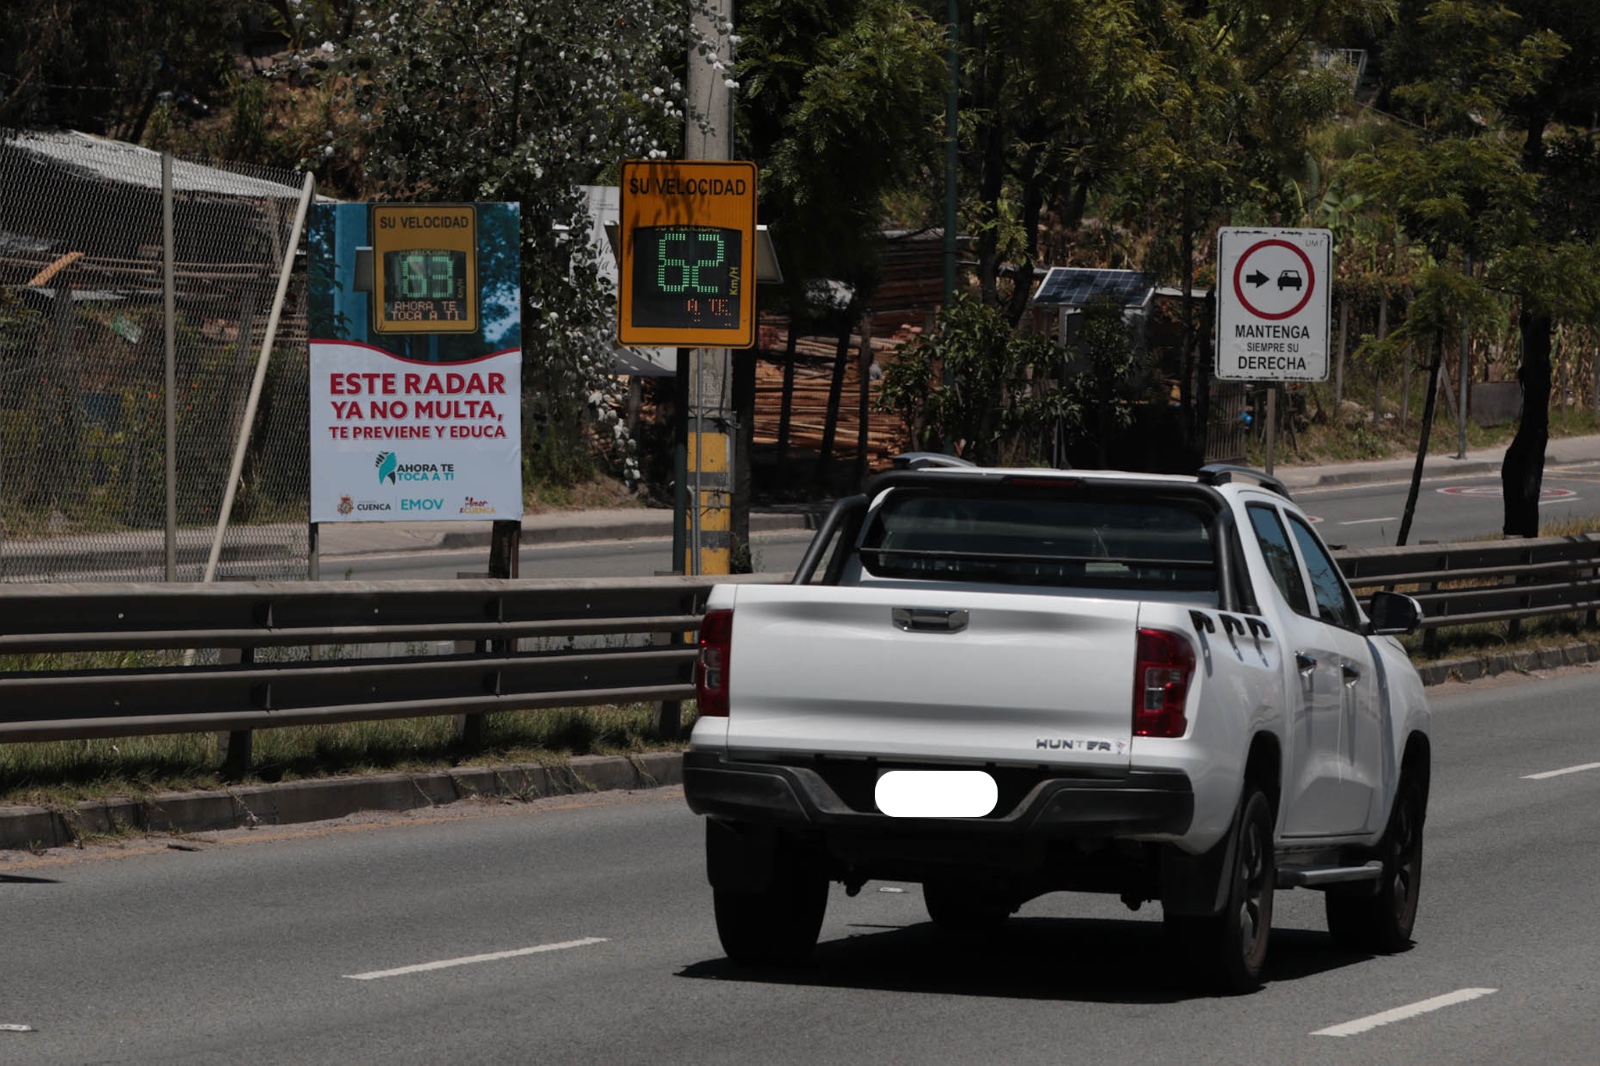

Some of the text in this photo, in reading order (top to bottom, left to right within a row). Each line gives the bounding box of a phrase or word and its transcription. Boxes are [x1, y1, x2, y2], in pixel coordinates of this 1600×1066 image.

[630, 178, 746, 195] SU VELOCIDAD
[380, 216, 469, 229] SU VELOCIDAD
[658, 233, 724, 292] 62
[729, 266, 739, 296] Km/H
[394, 301, 457, 311] AHORA TE
[391, 311, 460, 320] TOCA A TI
[1235, 325, 1310, 339] MANTENGA
[1247, 342, 1299, 353] SIEMPRE SU
[1238, 356, 1306, 370] DERECHA
[330, 372, 506, 395] ESTE RADAR
[331, 400, 504, 422] YA NO MULTA,
[329, 425, 506, 439] TE PREVIENE Y EDUCA
[397, 464, 454, 472] AHORA TE
[397, 472, 454, 481] TOCA A TI
[357, 503, 391, 511] CUENCA
[401, 499, 445, 511] EMOV
[1036, 738, 1111, 751] HUNTER
